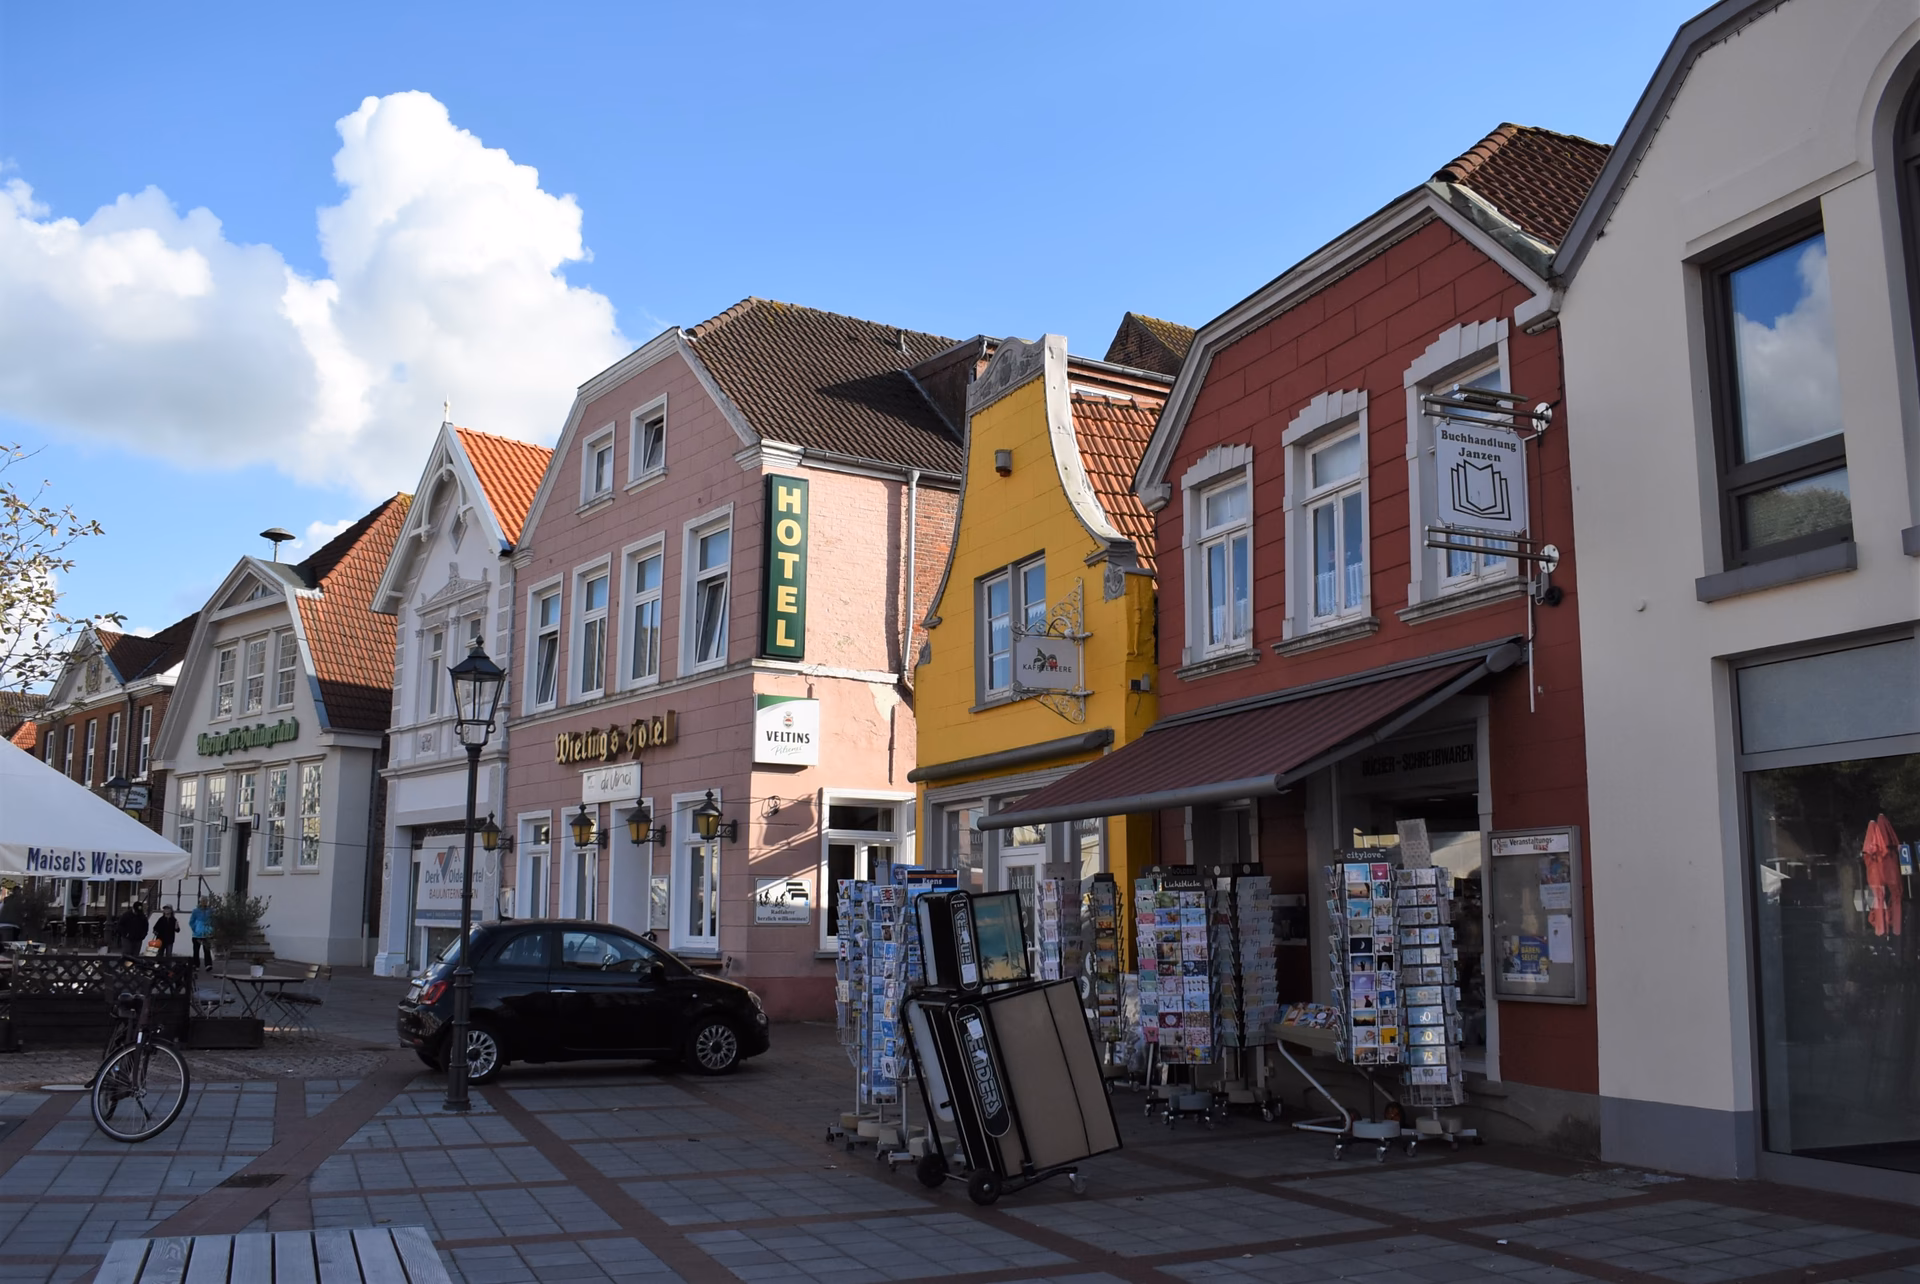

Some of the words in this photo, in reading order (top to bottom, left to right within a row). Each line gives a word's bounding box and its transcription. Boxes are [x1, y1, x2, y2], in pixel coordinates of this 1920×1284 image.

[1441, 430, 1516, 452] Buchhandlung
[1458, 447, 1501, 462] Janzen
[776, 485, 802, 648] HOTEL
[766, 730, 810, 744] VELTINS
[1402, 744, 1474, 771] SCHREIBWAREN
[1509, 837, 1554, 847] Veranstaltungs-
[26, 847, 86, 872] Maisel's
[91, 851, 143, 875] Weisse
[1346, 851, 1384, 860] citylove.
[425, 870, 440, 884] Derk
[922, 877, 943, 885] Esens
